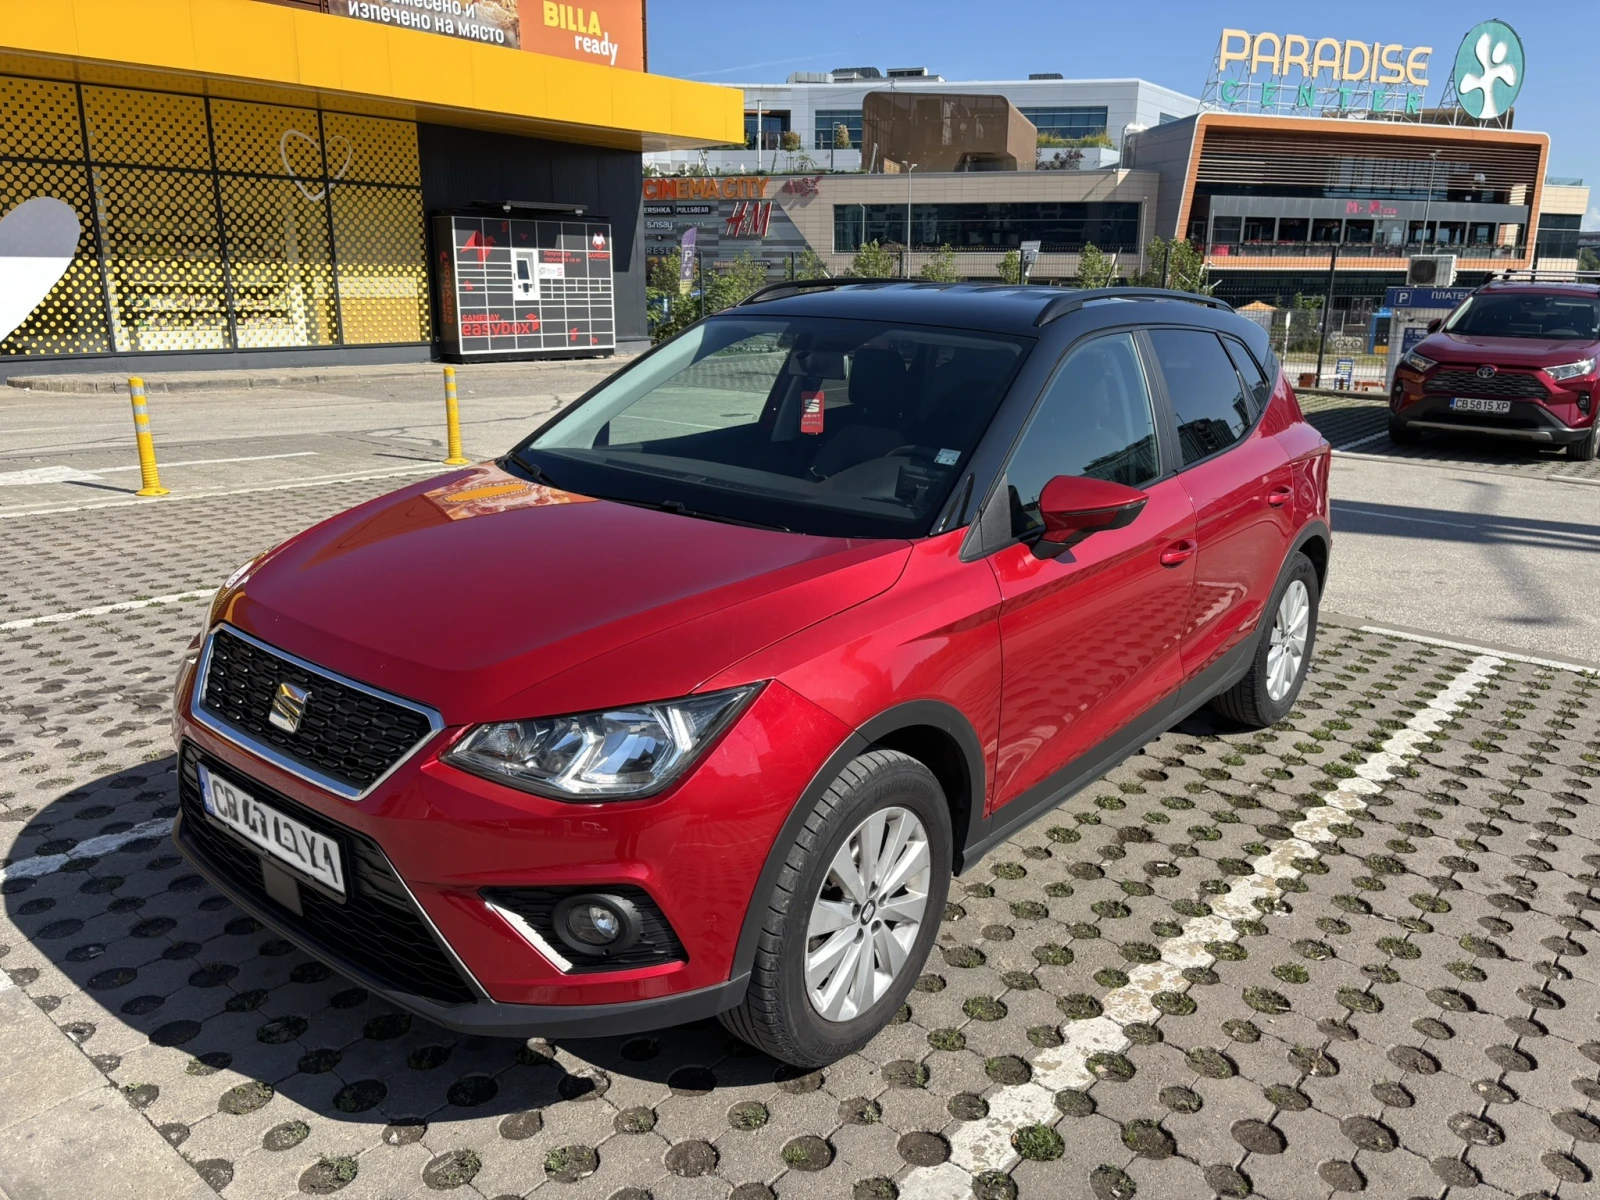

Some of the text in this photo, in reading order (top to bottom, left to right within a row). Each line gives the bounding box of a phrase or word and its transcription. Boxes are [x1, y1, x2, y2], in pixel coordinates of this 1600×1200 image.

[466, 3, 475, 18] и
[543, 0, 602, 36] BILLA
[348, 0, 504, 43] изпечено на място
[575, 31, 618, 66] ready
[1219, 28, 1433, 86] PARADISE
[1221, 79, 1421, 115] CENTER
[643, 176, 771, 200] CINEMA CITY
[643, 206, 671, 214] ERSHKA
[725, 201, 773, 237] H&M
[646, 220, 673, 230] sinsay
[684, 250, 692, 262] P
[1399, 292, 1409, 304] P
[462, 313, 500, 322] SAMEDAY
[462, 319, 530, 338] easybox
[1470, 400, 1493, 410] 5815
